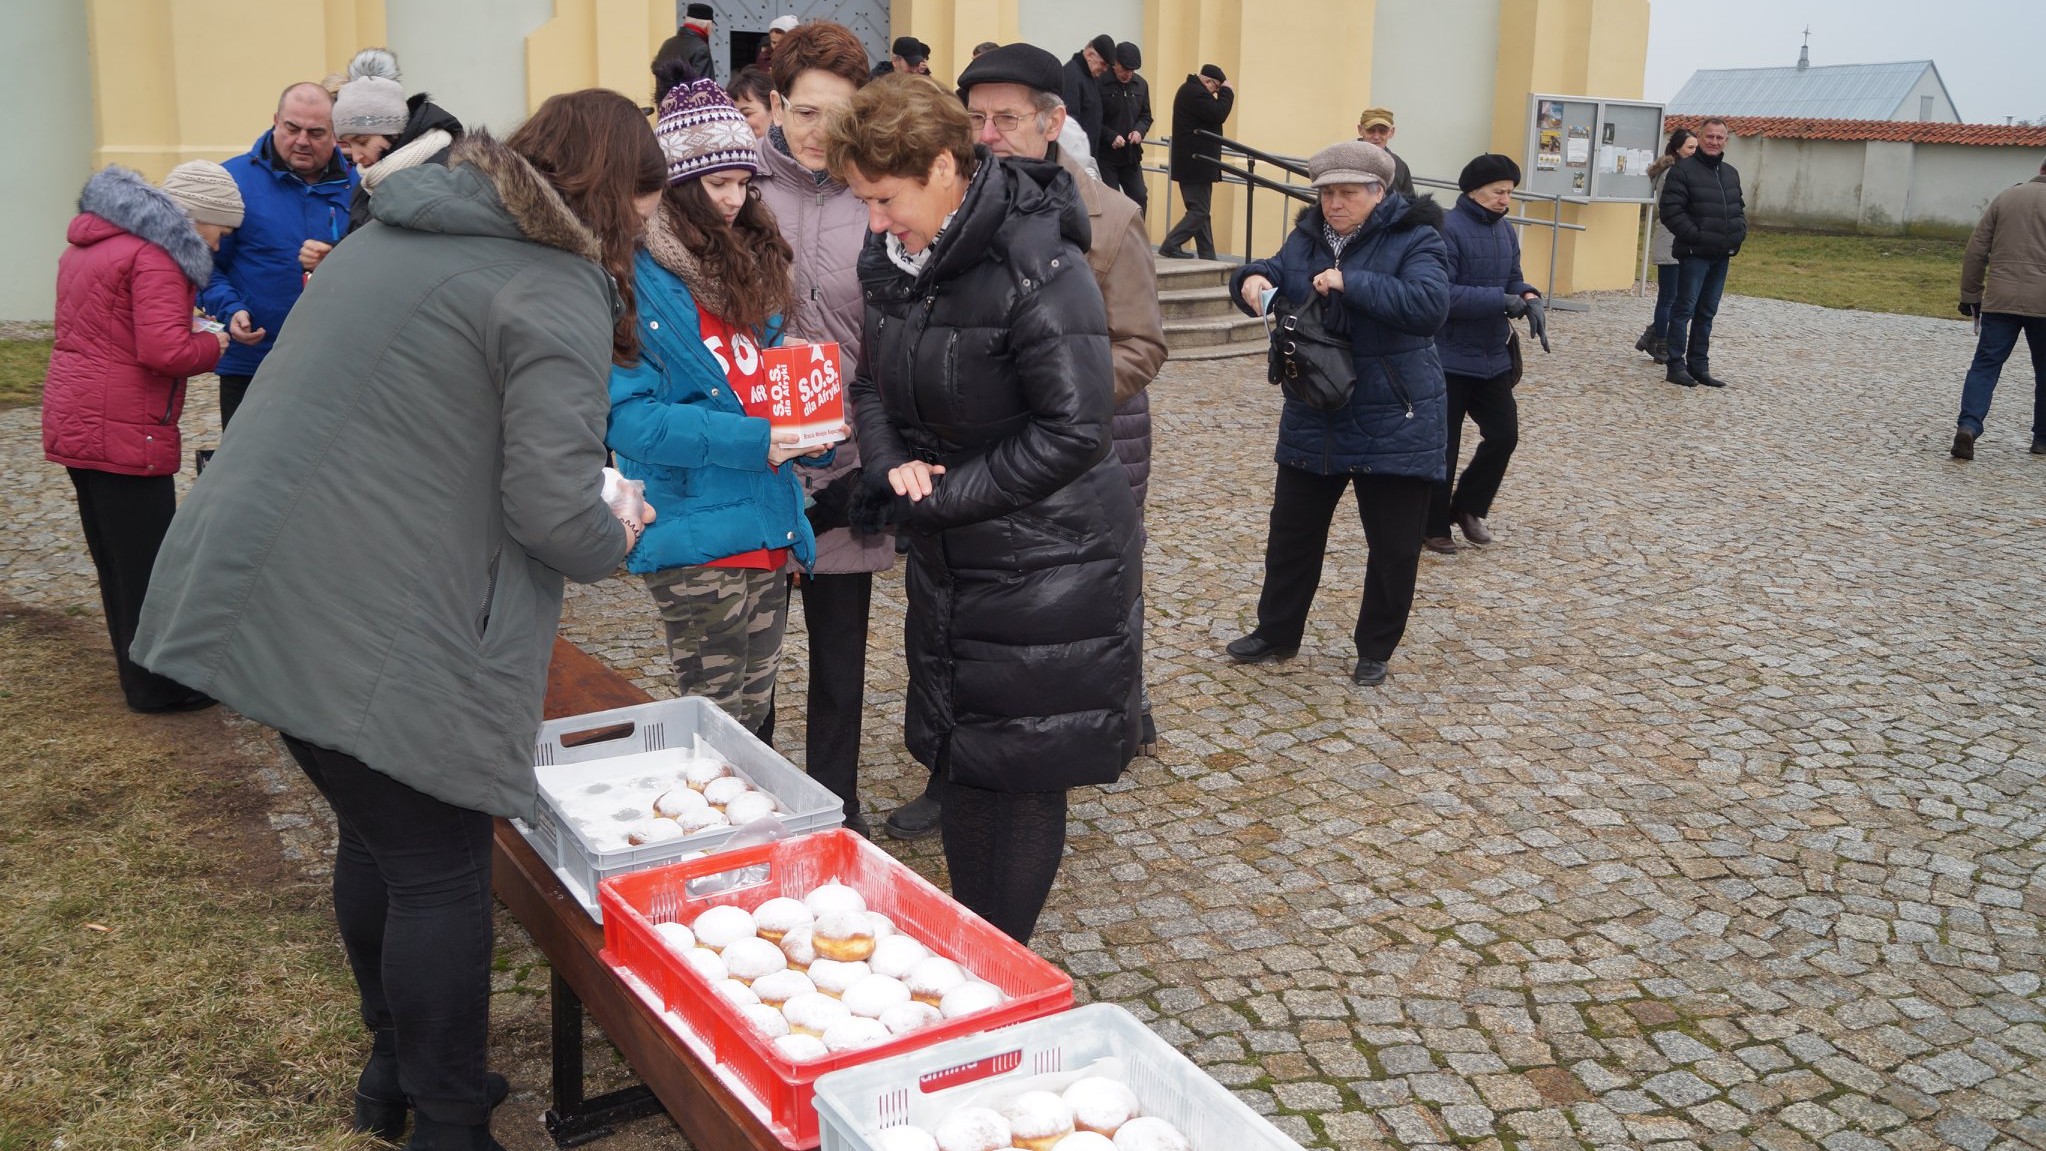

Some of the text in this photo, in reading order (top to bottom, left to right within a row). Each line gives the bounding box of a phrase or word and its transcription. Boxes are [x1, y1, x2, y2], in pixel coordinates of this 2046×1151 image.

[769, 364, 784, 416] S.O.S.
[780, 364, 790, 396] Afryki
[798, 360, 838, 402] S.O.S.
[804, 379, 840, 417] dla Afryki
